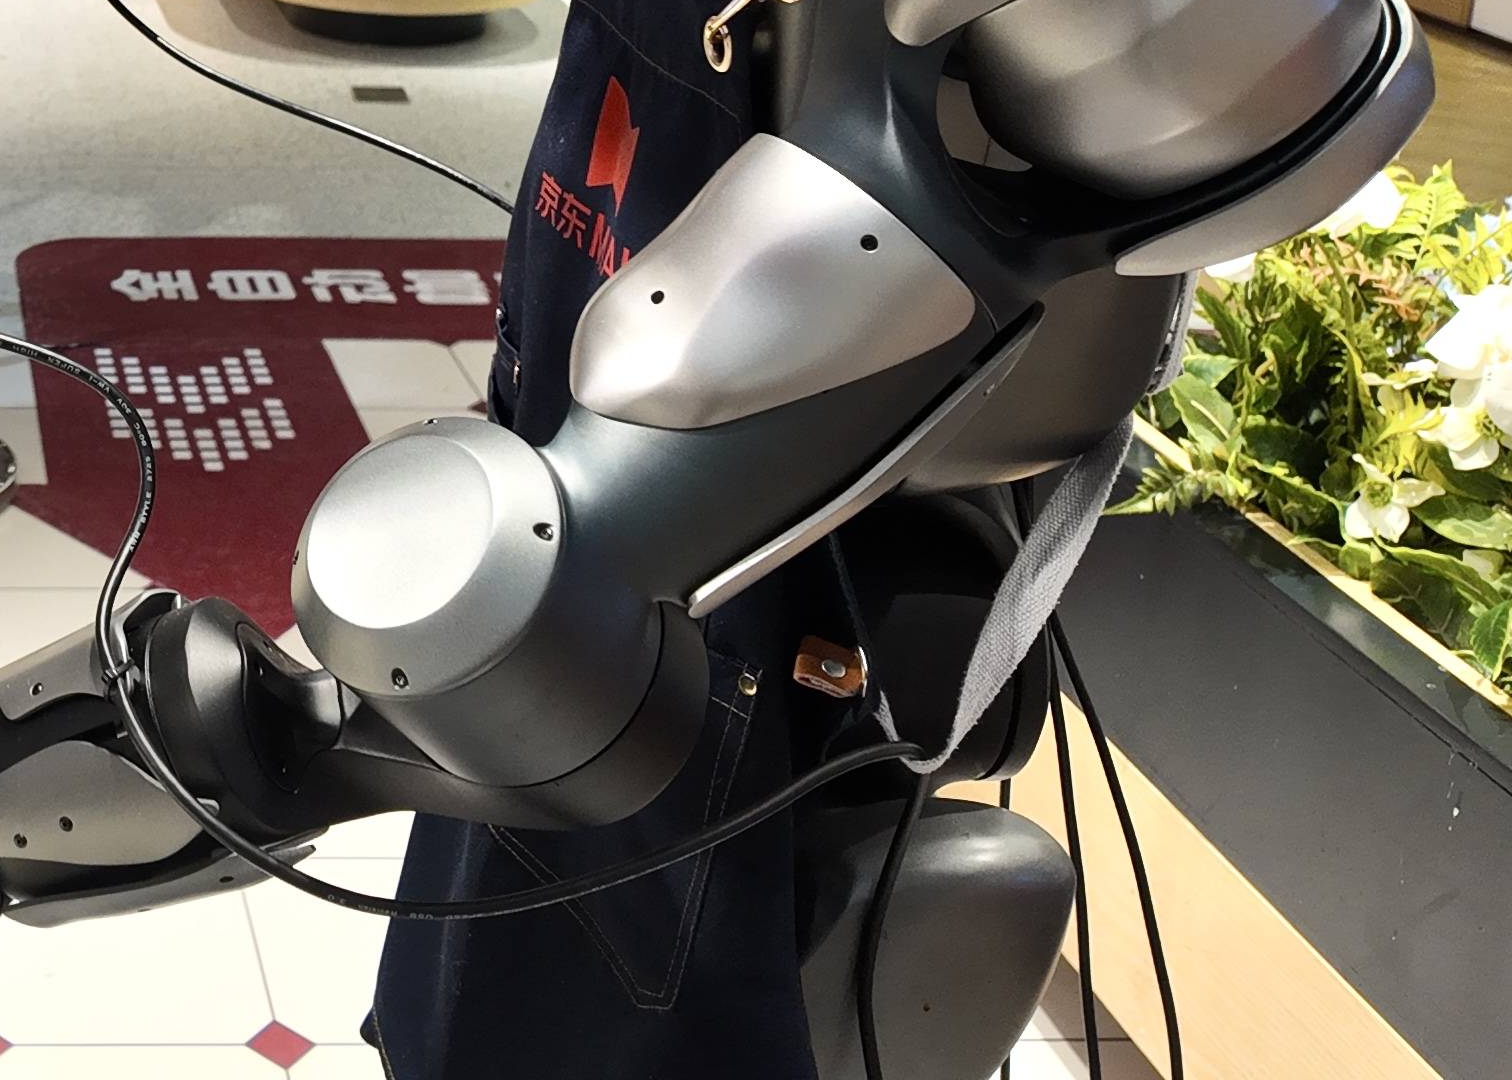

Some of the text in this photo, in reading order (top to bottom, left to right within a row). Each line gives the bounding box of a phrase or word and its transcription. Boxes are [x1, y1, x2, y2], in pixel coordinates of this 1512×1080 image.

[535, 171, 592, 249] 京东
[110, 269, 502, 306] 全自动
